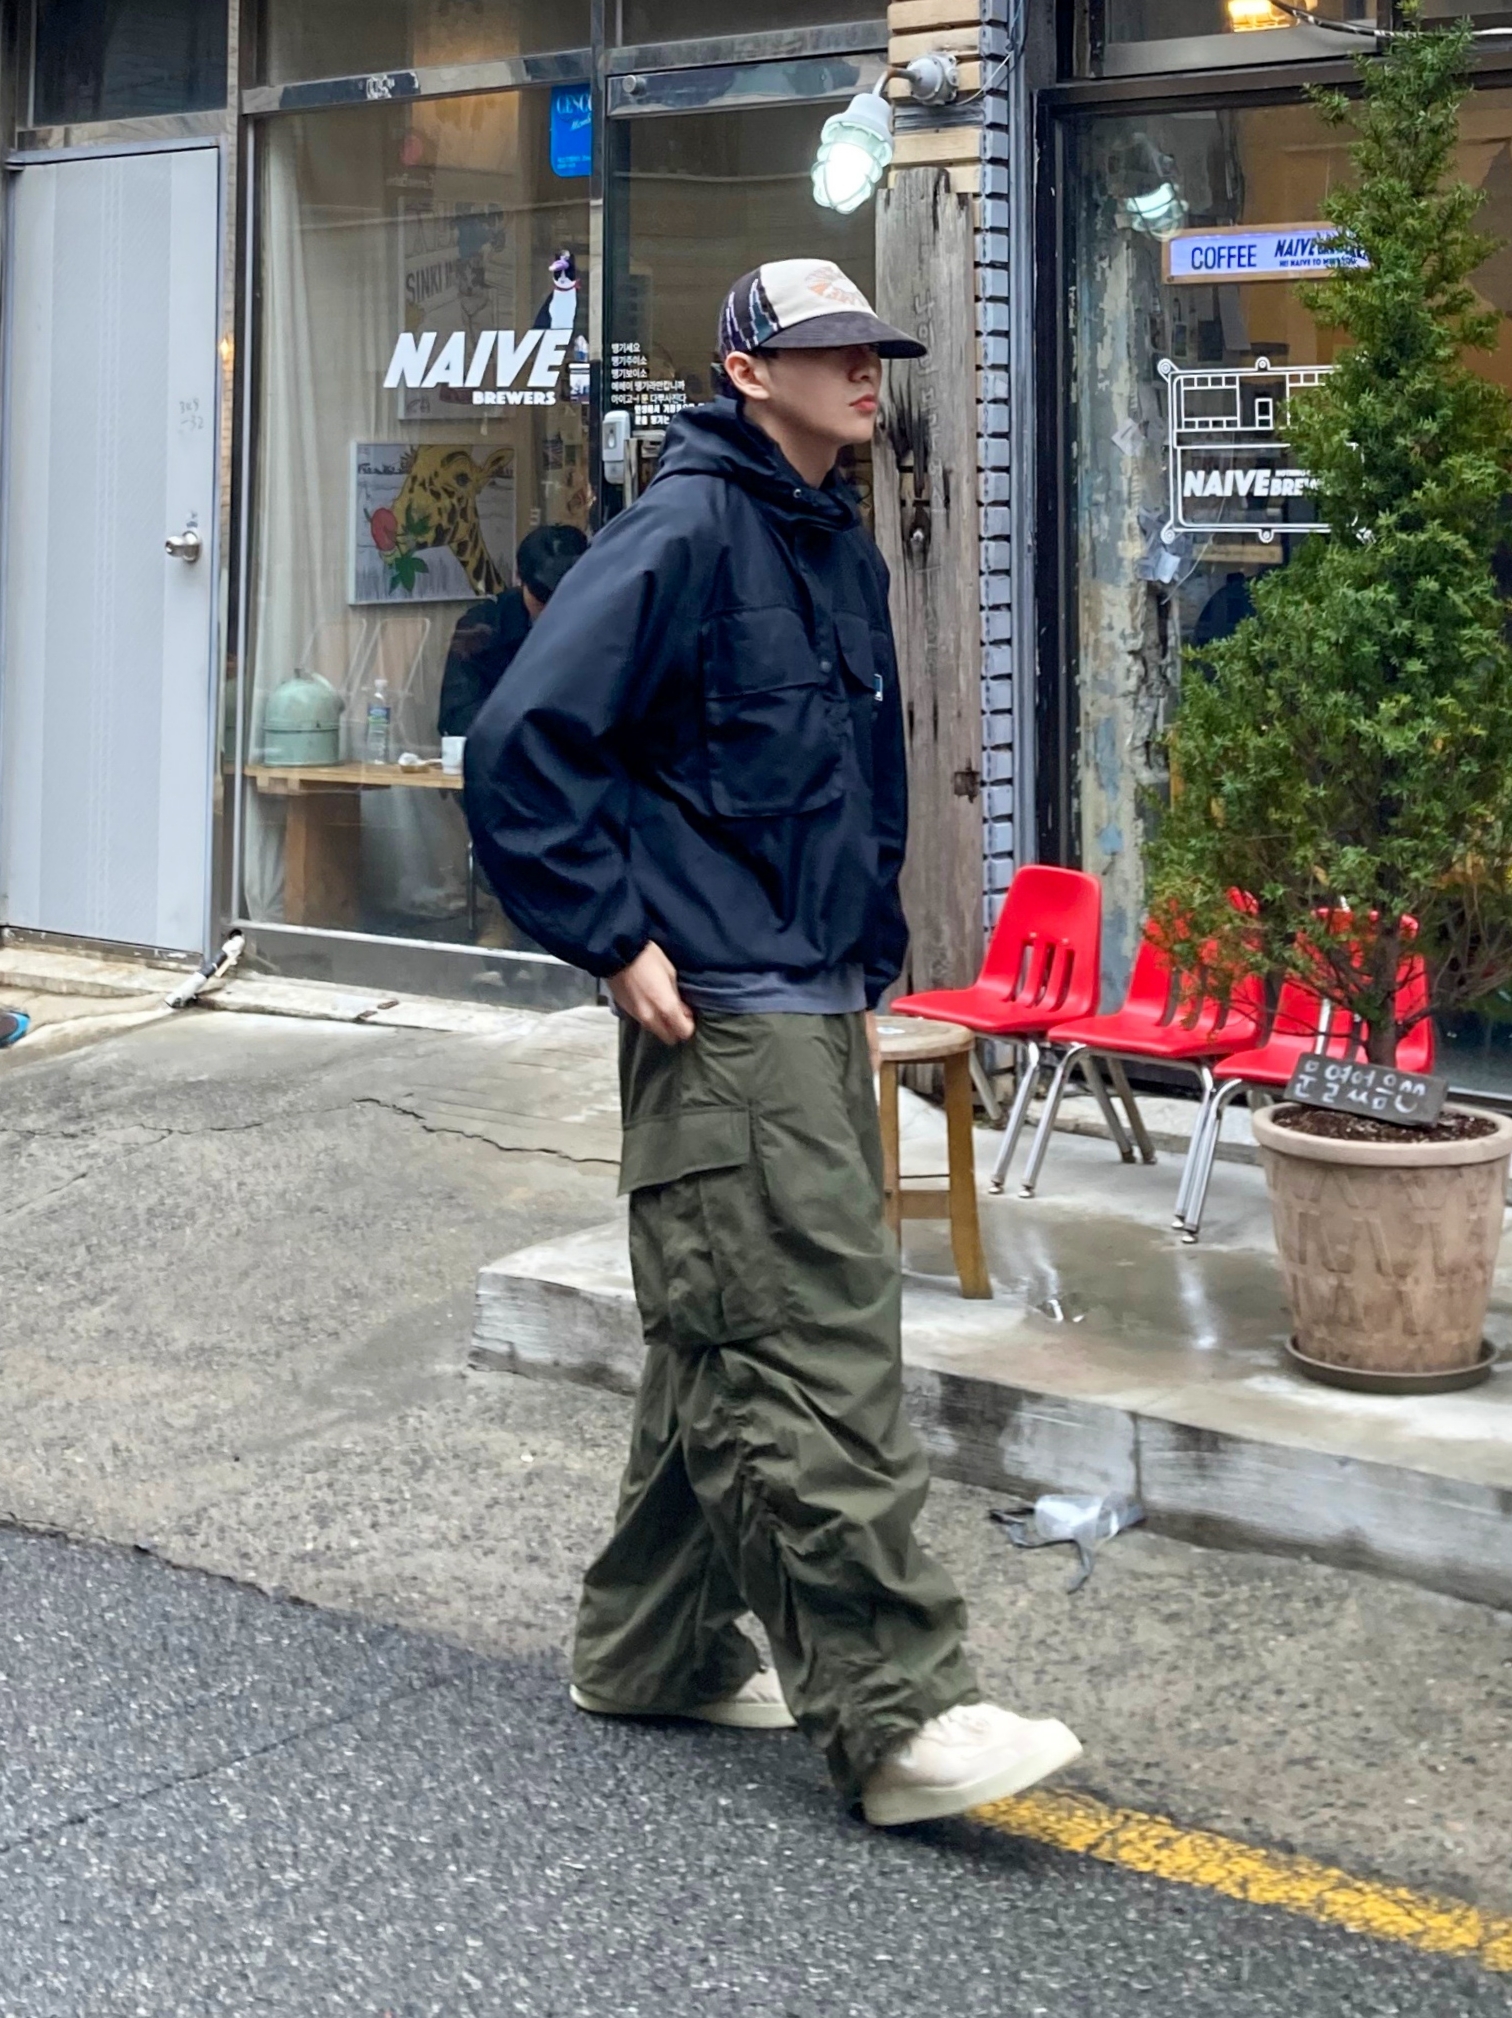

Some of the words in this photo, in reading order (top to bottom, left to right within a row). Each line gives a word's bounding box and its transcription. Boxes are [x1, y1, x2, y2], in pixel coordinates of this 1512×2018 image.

[1191, 244, 1257, 270] COFFEE
[383, 329, 573, 388] NAIVE
[472, 391, 556, 405] BREWERS
[1183, 469, 1271, 497] NAIVE
[1294, 1060, 1319, 1098] 문
